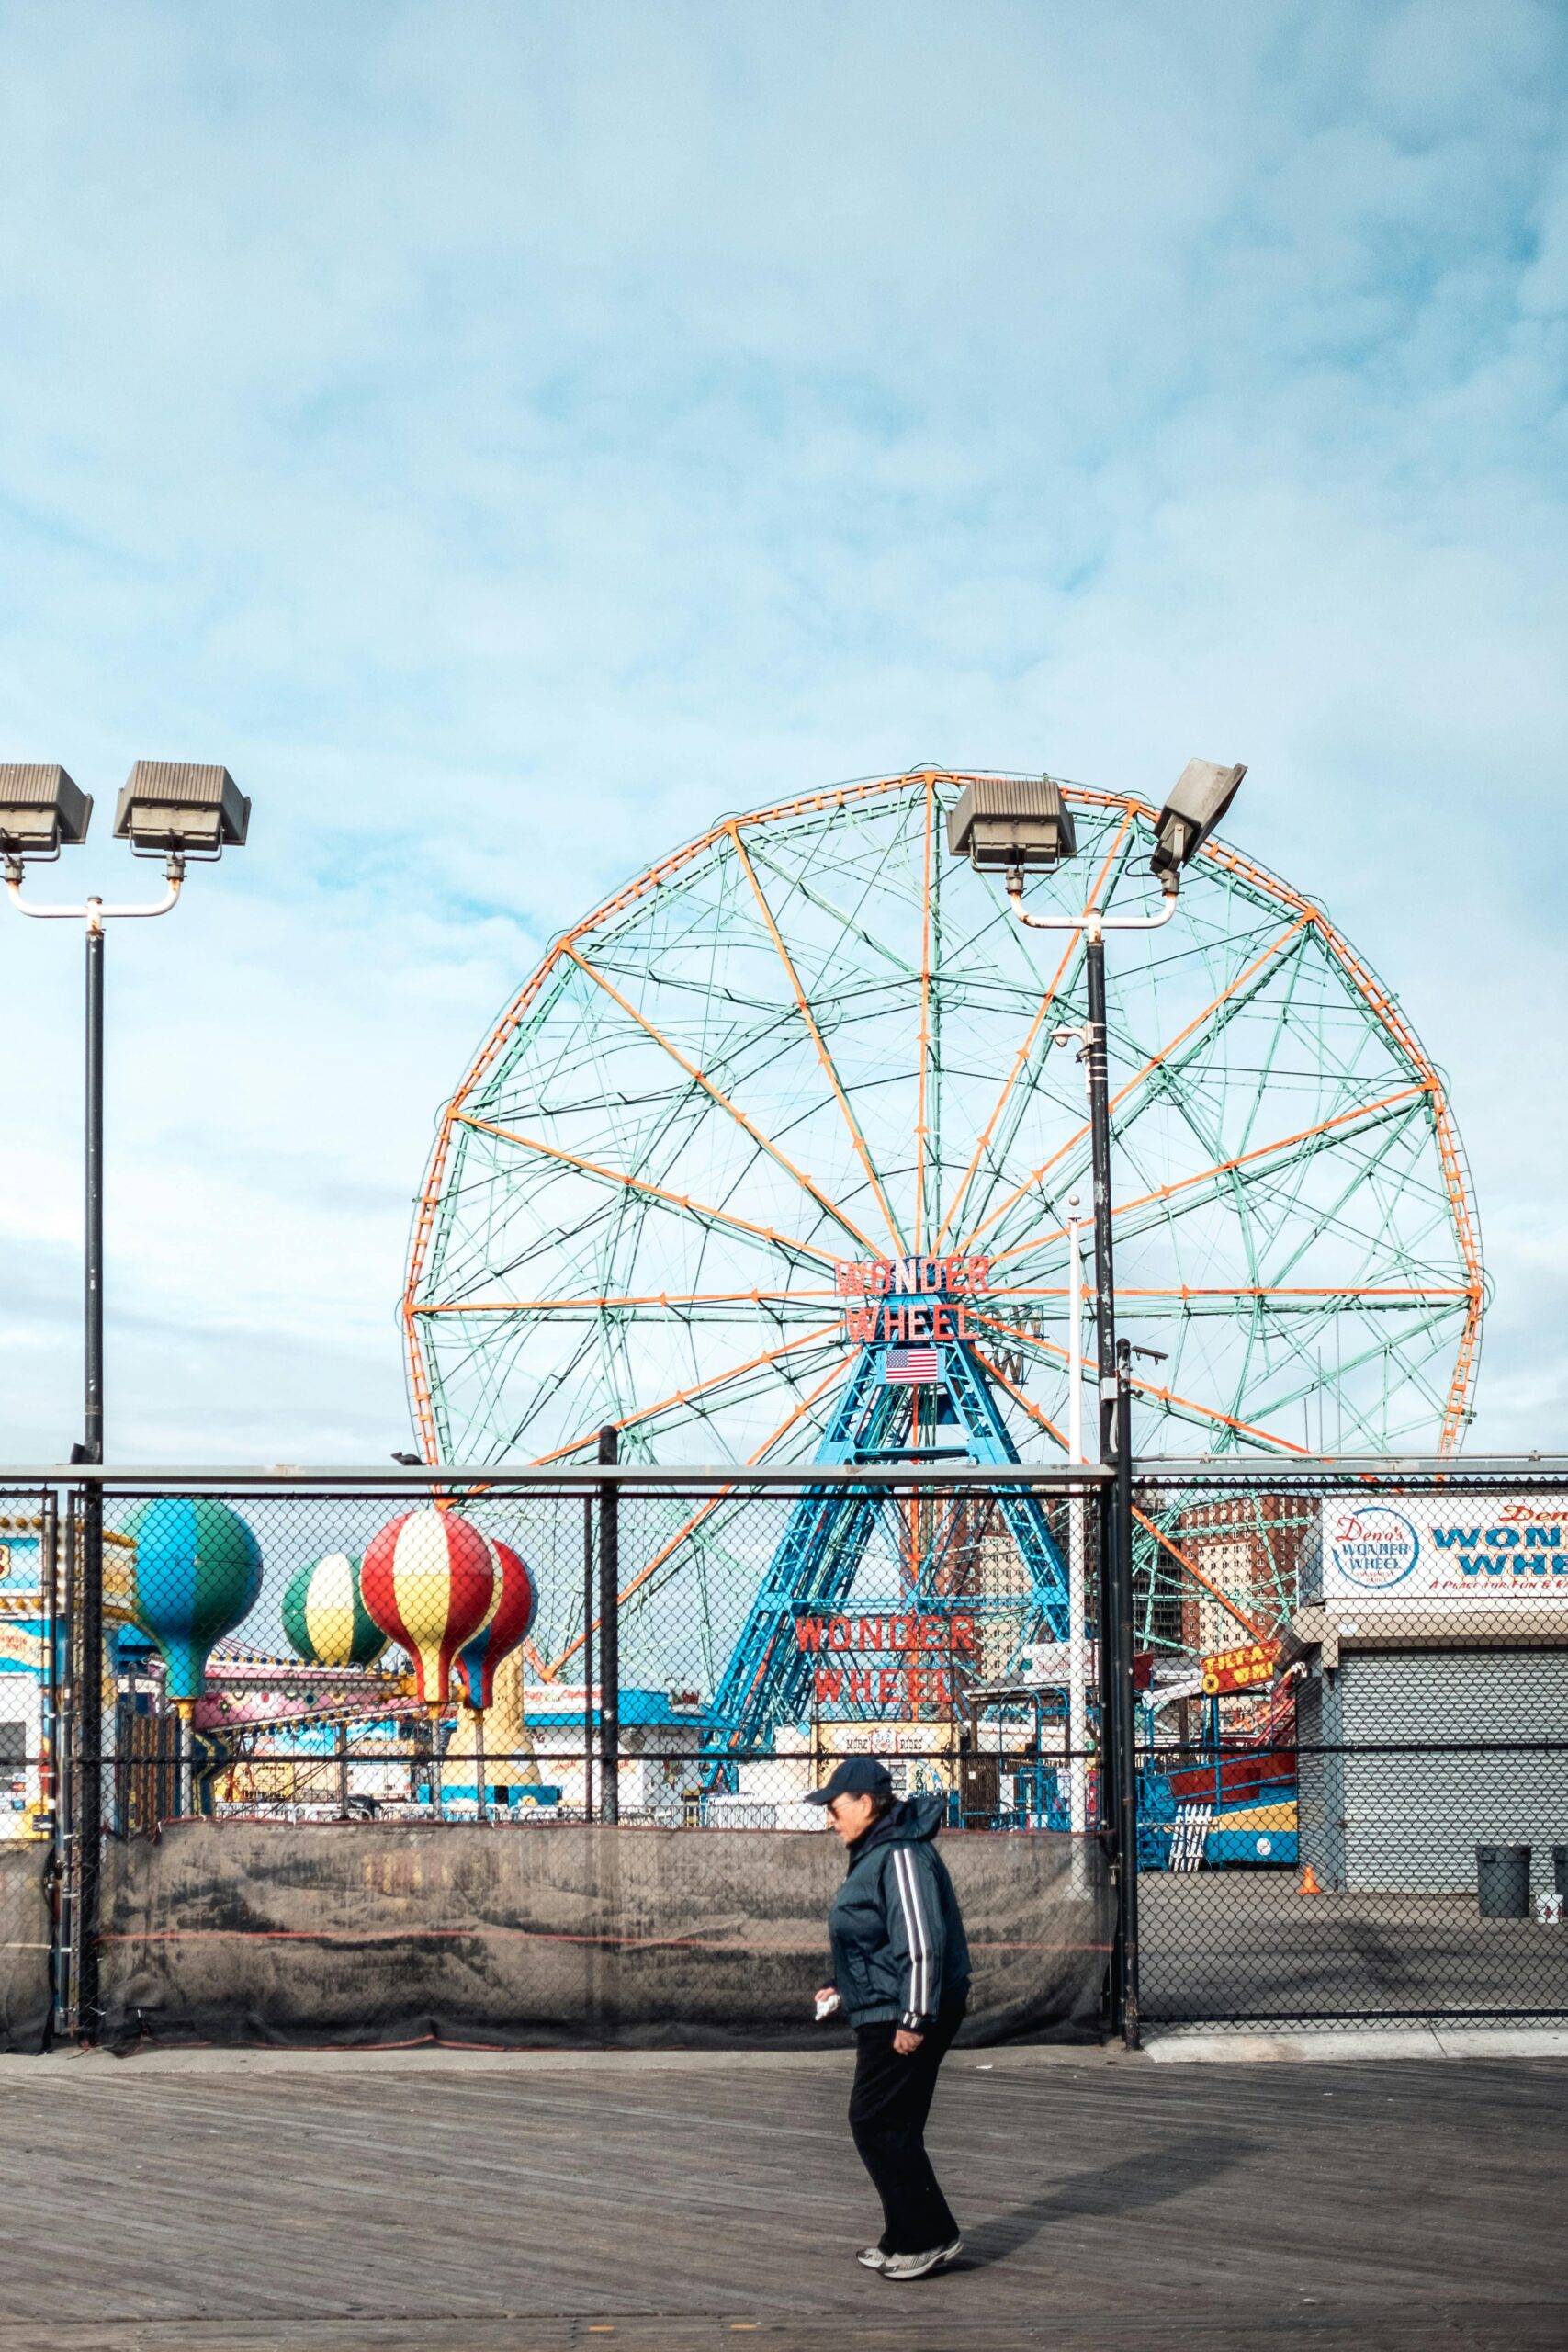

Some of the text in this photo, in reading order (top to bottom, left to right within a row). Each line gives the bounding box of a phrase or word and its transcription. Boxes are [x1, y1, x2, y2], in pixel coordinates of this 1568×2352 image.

[834, 1255, 988, 1296] WONDER
[845, 1304, 979, 1341] WHEEL
[1335, 1517, 1403, 1542] Deno's
[1342, 1544, 1409, 1555] WONDER
[1349, 1557, 1401, 1569] WHEEL
[795, 1615, 975, 1652] WONDER
[814, 1668, 953, 1703] WHEEL
[846, 1738, 923, 1750] MORE RIDES
